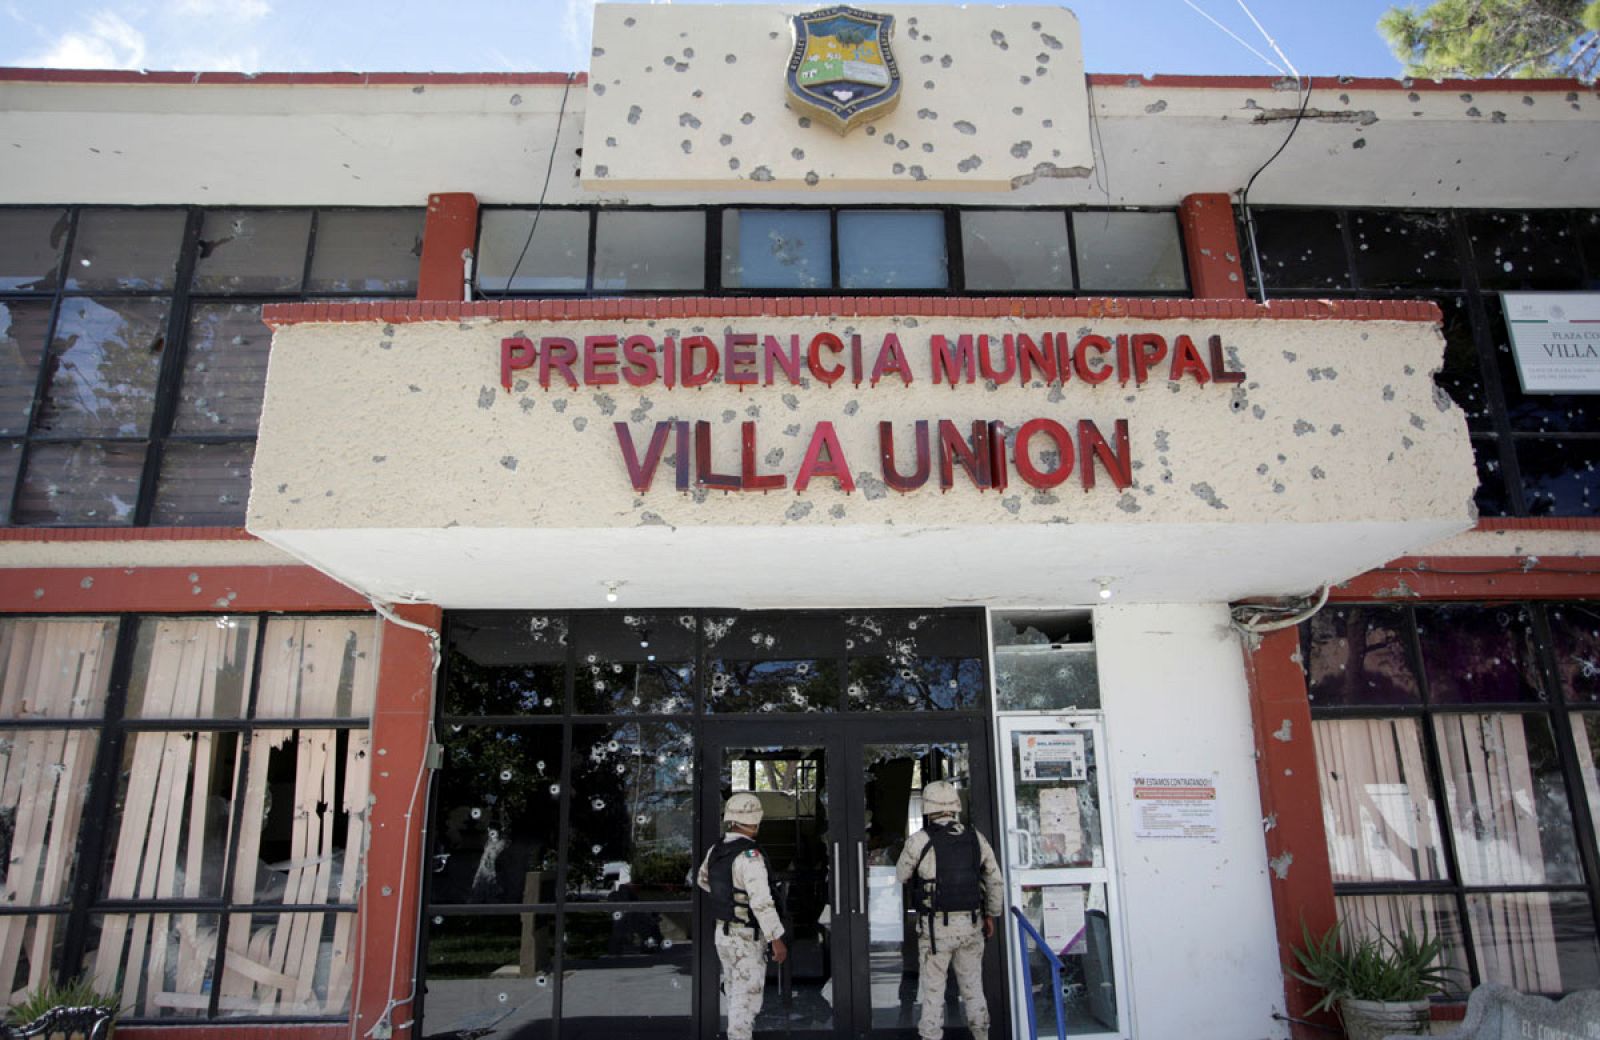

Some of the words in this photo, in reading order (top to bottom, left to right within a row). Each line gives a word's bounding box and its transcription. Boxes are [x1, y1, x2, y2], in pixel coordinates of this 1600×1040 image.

[1542, 344, 1598, 357] VILLA
[1552, 332, 1580, 340] PLAZA
[500, 332, 913, 389] PRESIDENCIA
[930, 332, 1246, 386] MUNICIPAL
[613, 420, 855, 492] VILLA
[879, 418, 1132, 493] UNION
